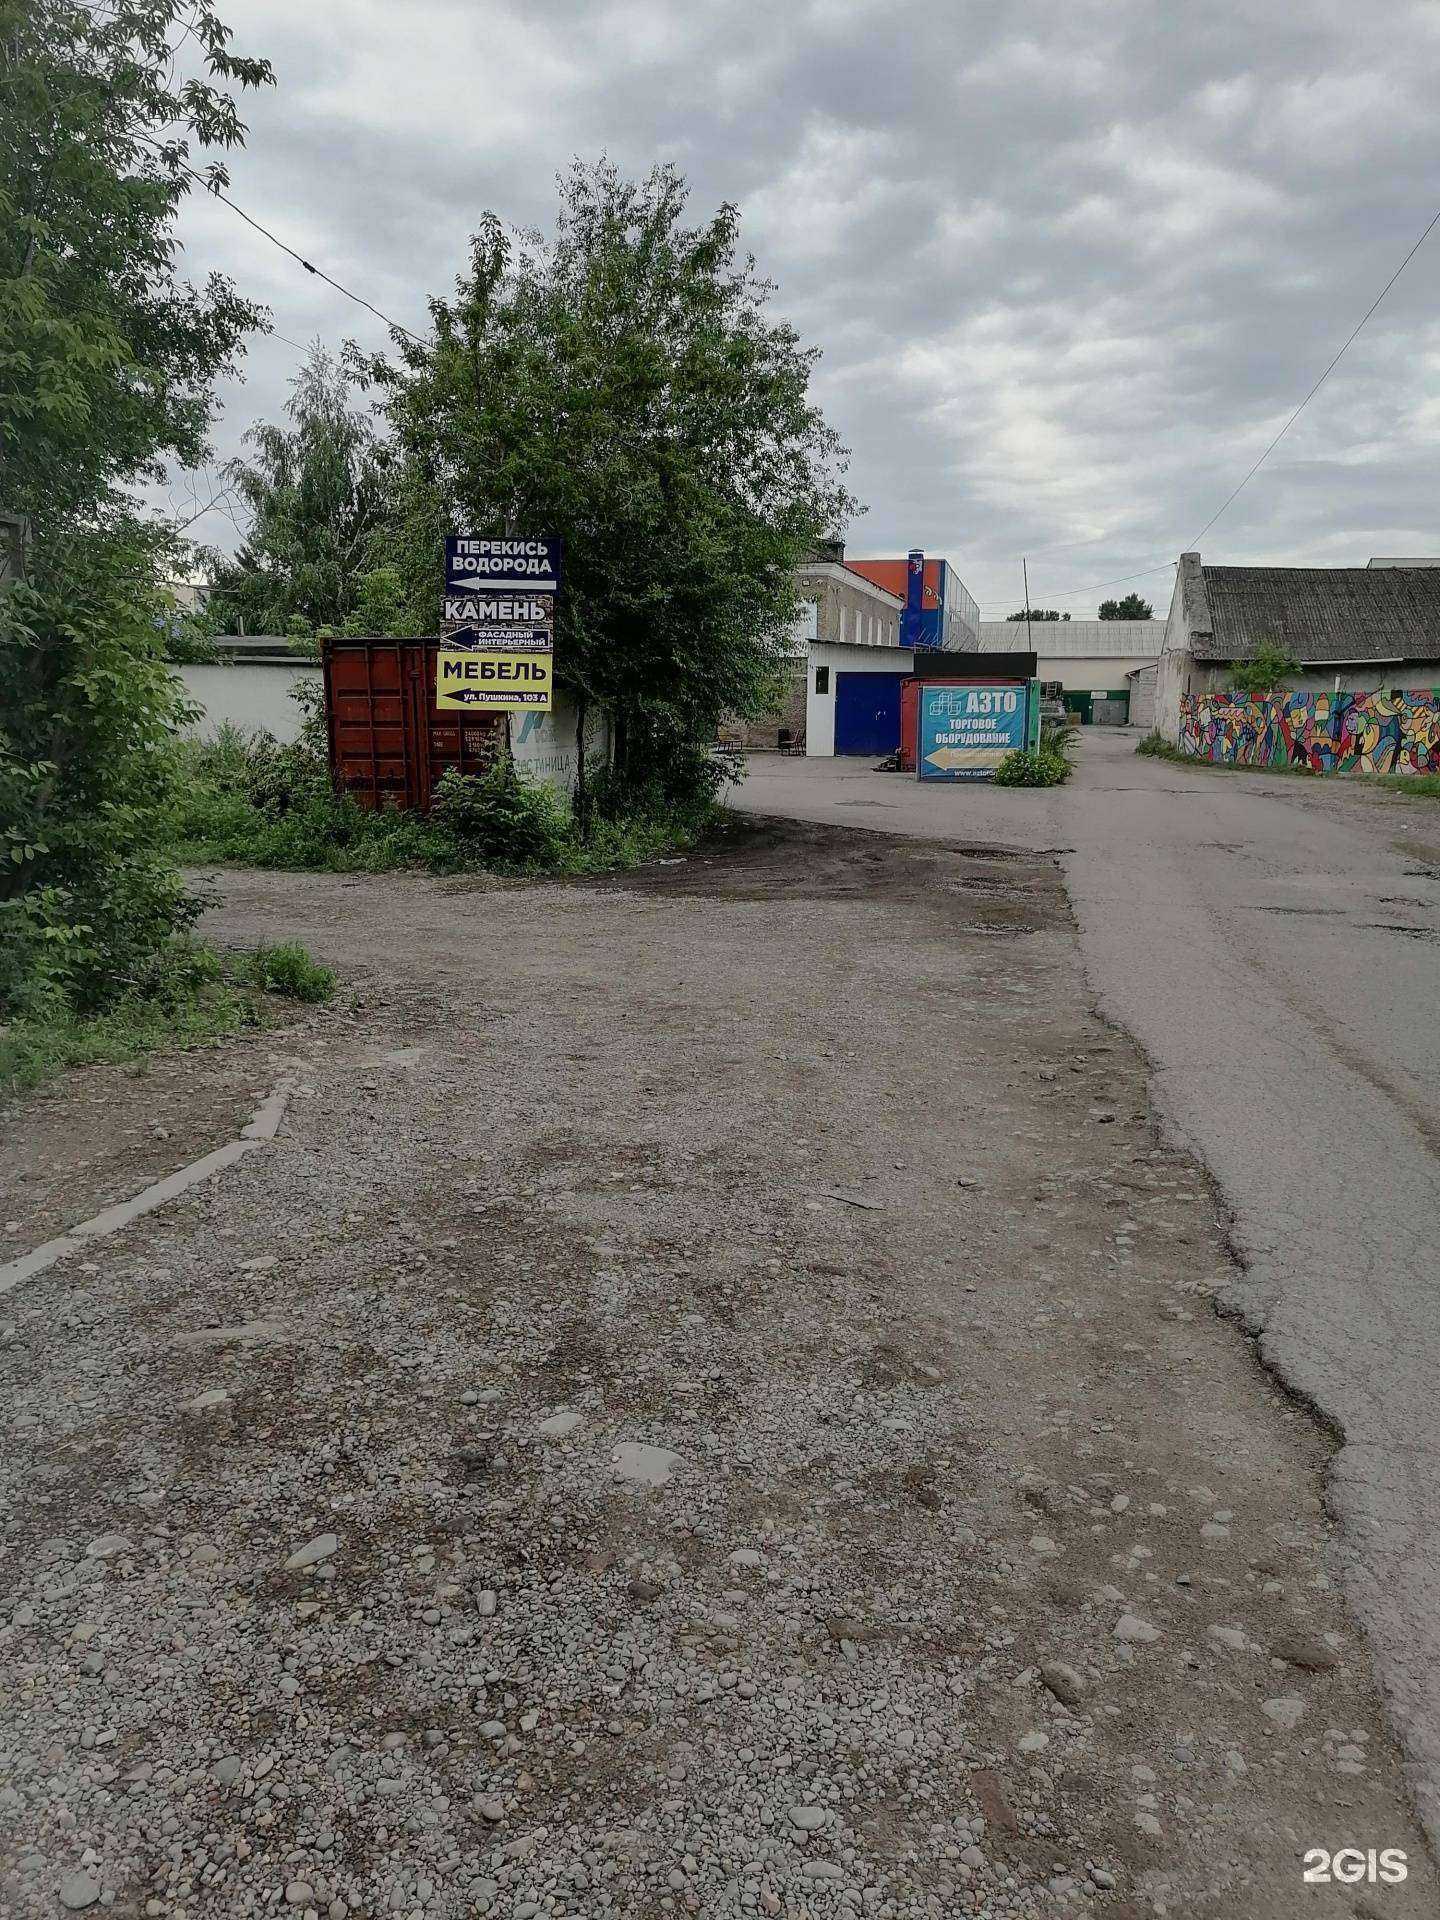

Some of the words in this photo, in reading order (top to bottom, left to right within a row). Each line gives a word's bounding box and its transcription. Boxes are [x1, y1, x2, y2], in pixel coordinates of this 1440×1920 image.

[456, 540, 548, 556] ПЕРЕКИСЬ
[452, 556, 552, 574] ВОДОРОДА
[445, 602, 546, 620] КАМЕНЬ
[478, 630, 533, 639] ФАСАДНЫЙ
[478, 637, 546, 646] ИНТЕРЬЕРНЫЙ
[443, 661, 547, 681] МЕБЕЛЬ
[463, 693, 476, 702] ул.
[479, 693, 521, 703] Пушкина,
[523, 694, 538, 702] 103
[965, 691, 1017, 713] АЗТО
[949, 718, 997, 730] ТОРГОВОЕ
[935, 732, 1011, 745] ОБОРУДОВАНИЕ
